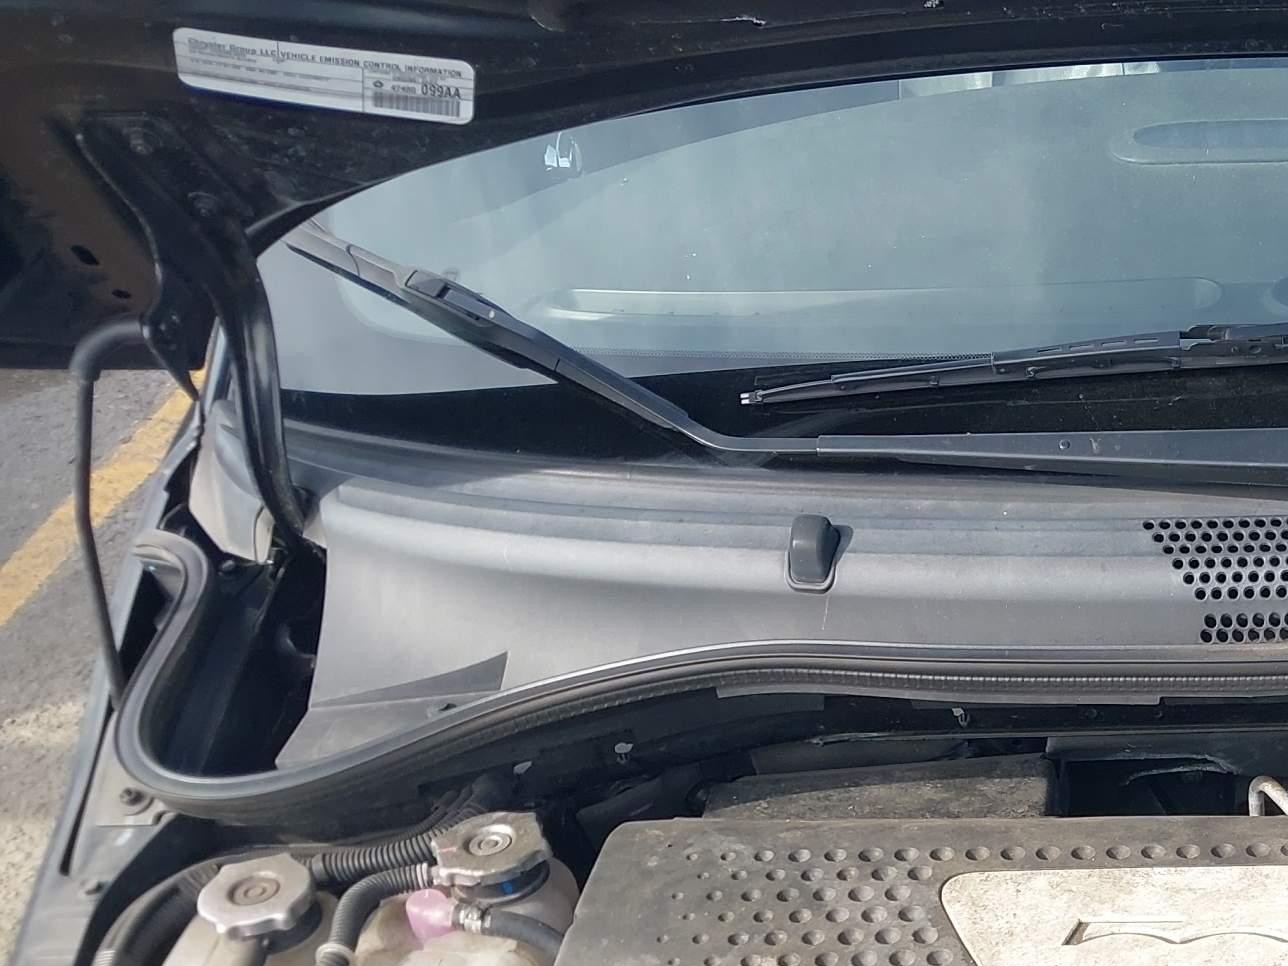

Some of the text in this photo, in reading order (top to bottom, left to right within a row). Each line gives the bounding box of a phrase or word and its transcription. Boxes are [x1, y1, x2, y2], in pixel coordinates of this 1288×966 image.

[259, 48, 277, 58] LLC
[280, 51, 316, 62] VEHICLE
[319, 56, 360, 68] EMISSION
[363, 60, 402, 72] CONTROL
[405, 64, 462, 78] INFORMATION
[421, 84, 462, 99] 099AA
